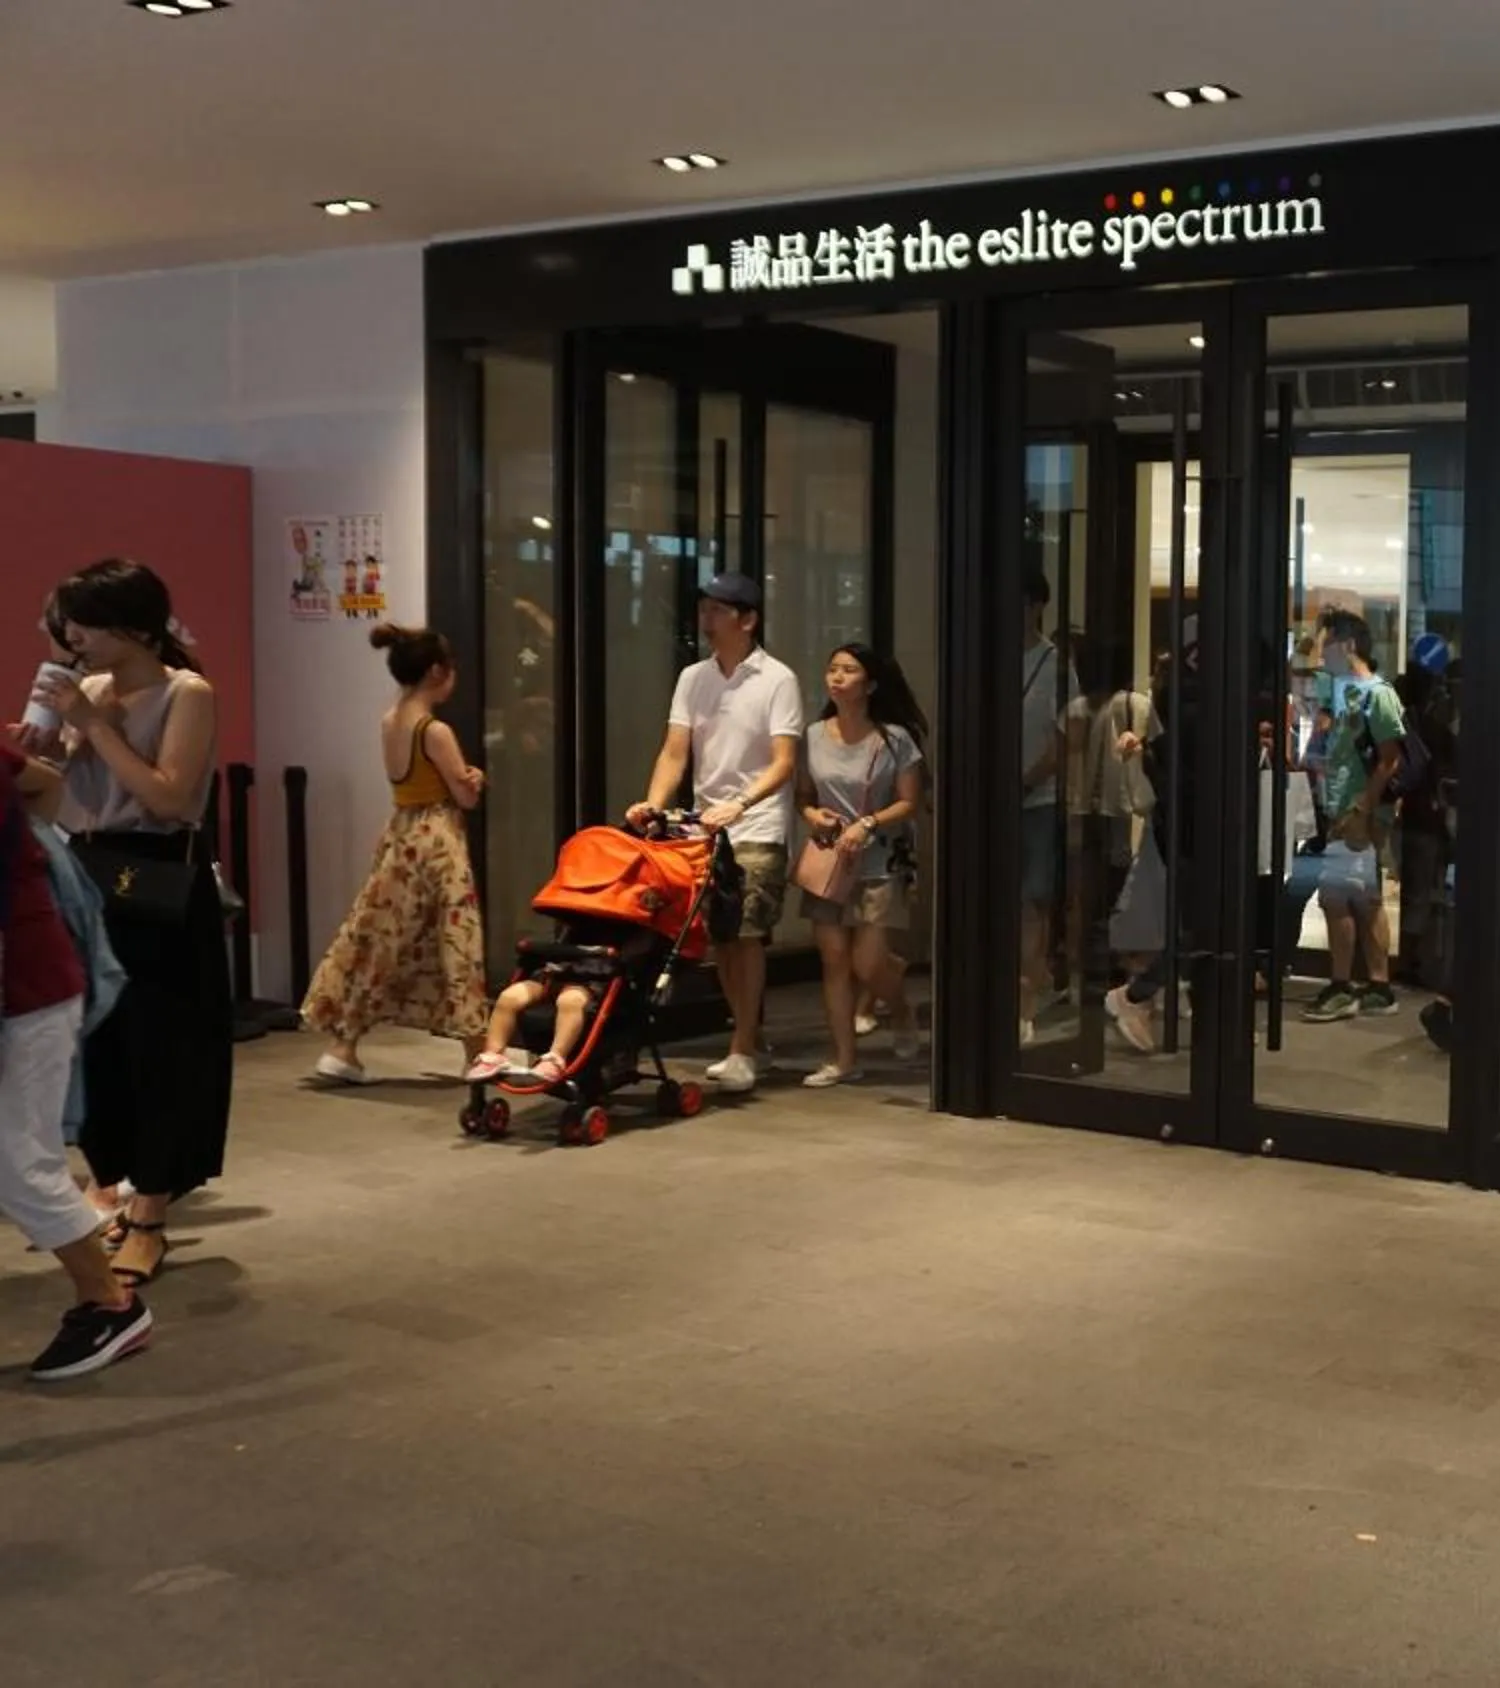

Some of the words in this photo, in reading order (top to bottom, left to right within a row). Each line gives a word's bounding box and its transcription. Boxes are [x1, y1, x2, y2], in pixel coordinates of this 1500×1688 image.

[730, 222, 896, 292] 誠品生活
[902, 219, 971, 273] the
[978, 207, 1095, 265] eslite
[1102, 196, 1325, 270] spectrum
